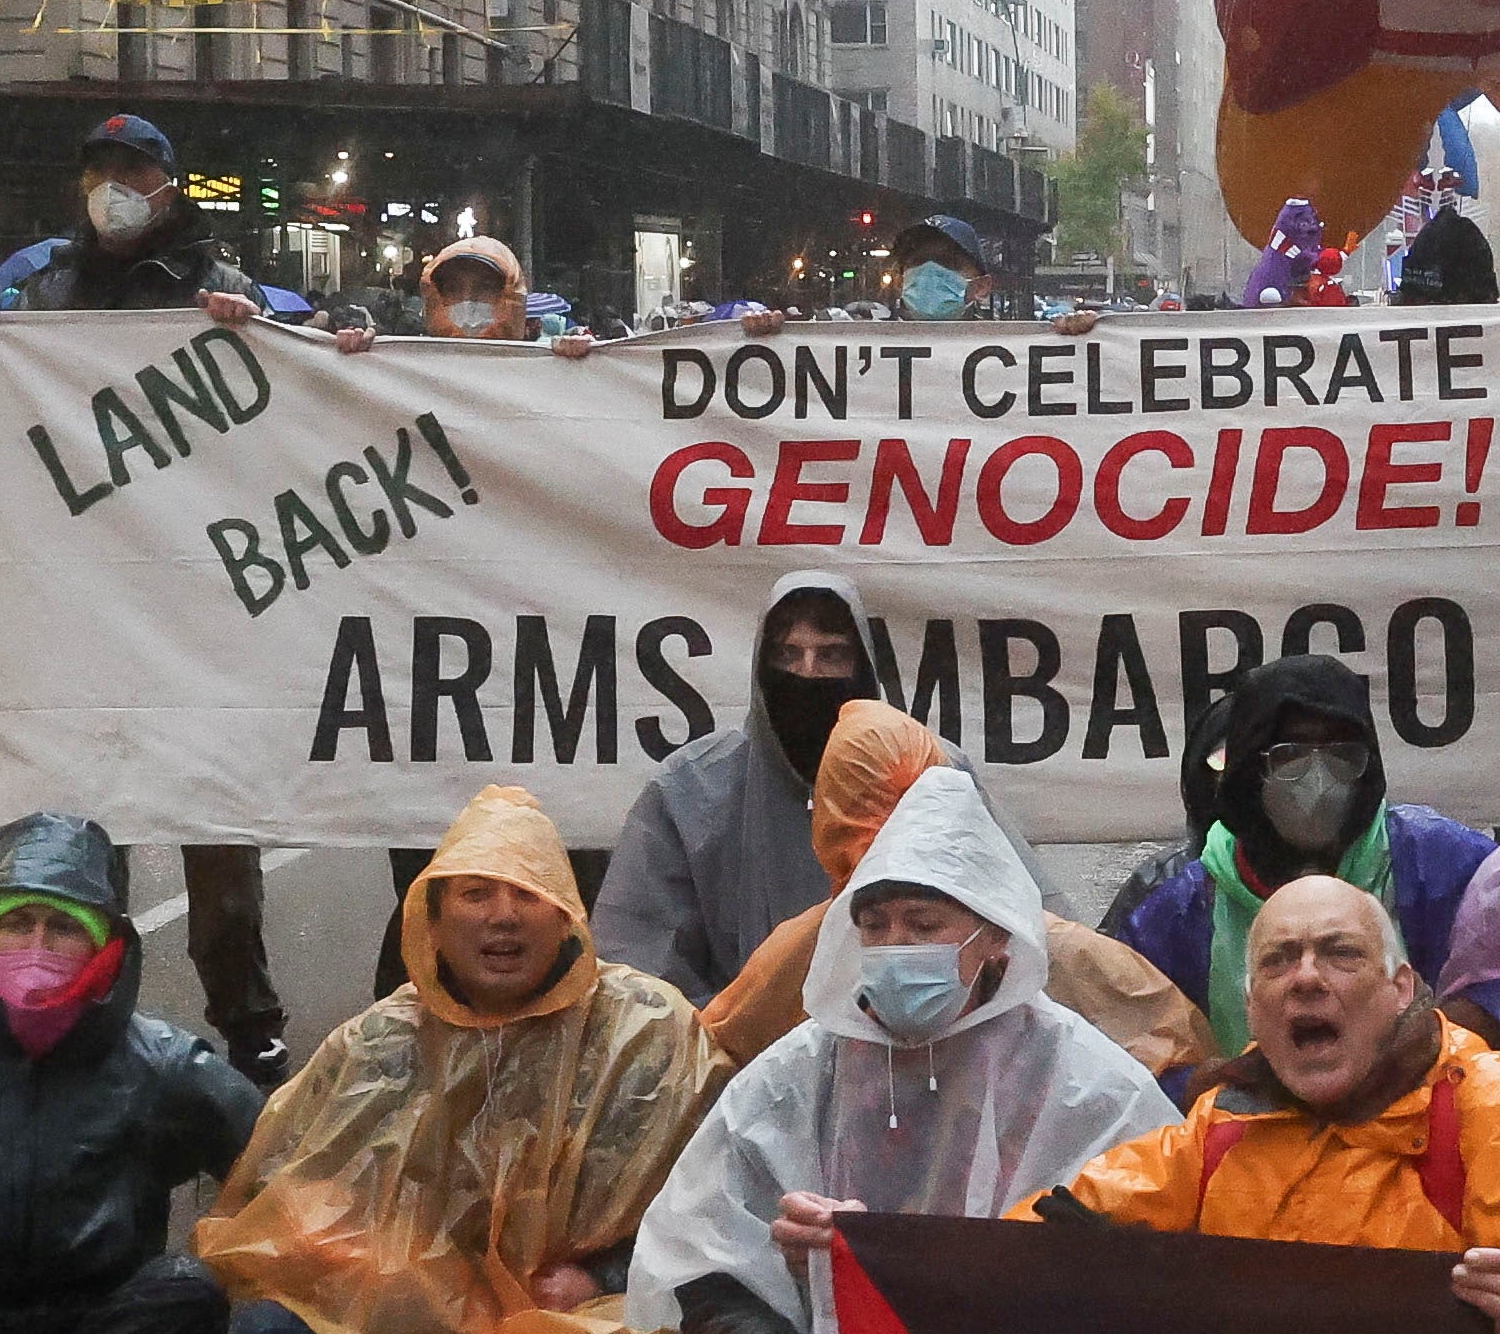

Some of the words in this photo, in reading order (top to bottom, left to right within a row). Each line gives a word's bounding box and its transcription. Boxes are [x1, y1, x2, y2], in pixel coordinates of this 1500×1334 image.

[26, 326, 271, 517] LAND
[662, 344, 931, 420] DON'T
[962, 325, 1487, 420] CELEBRATE
[206, 411, 472, 618] BACK!
[649, 417, 1494, 551] GENOCIDE!
[309, 615, 716, 764] ARMS
